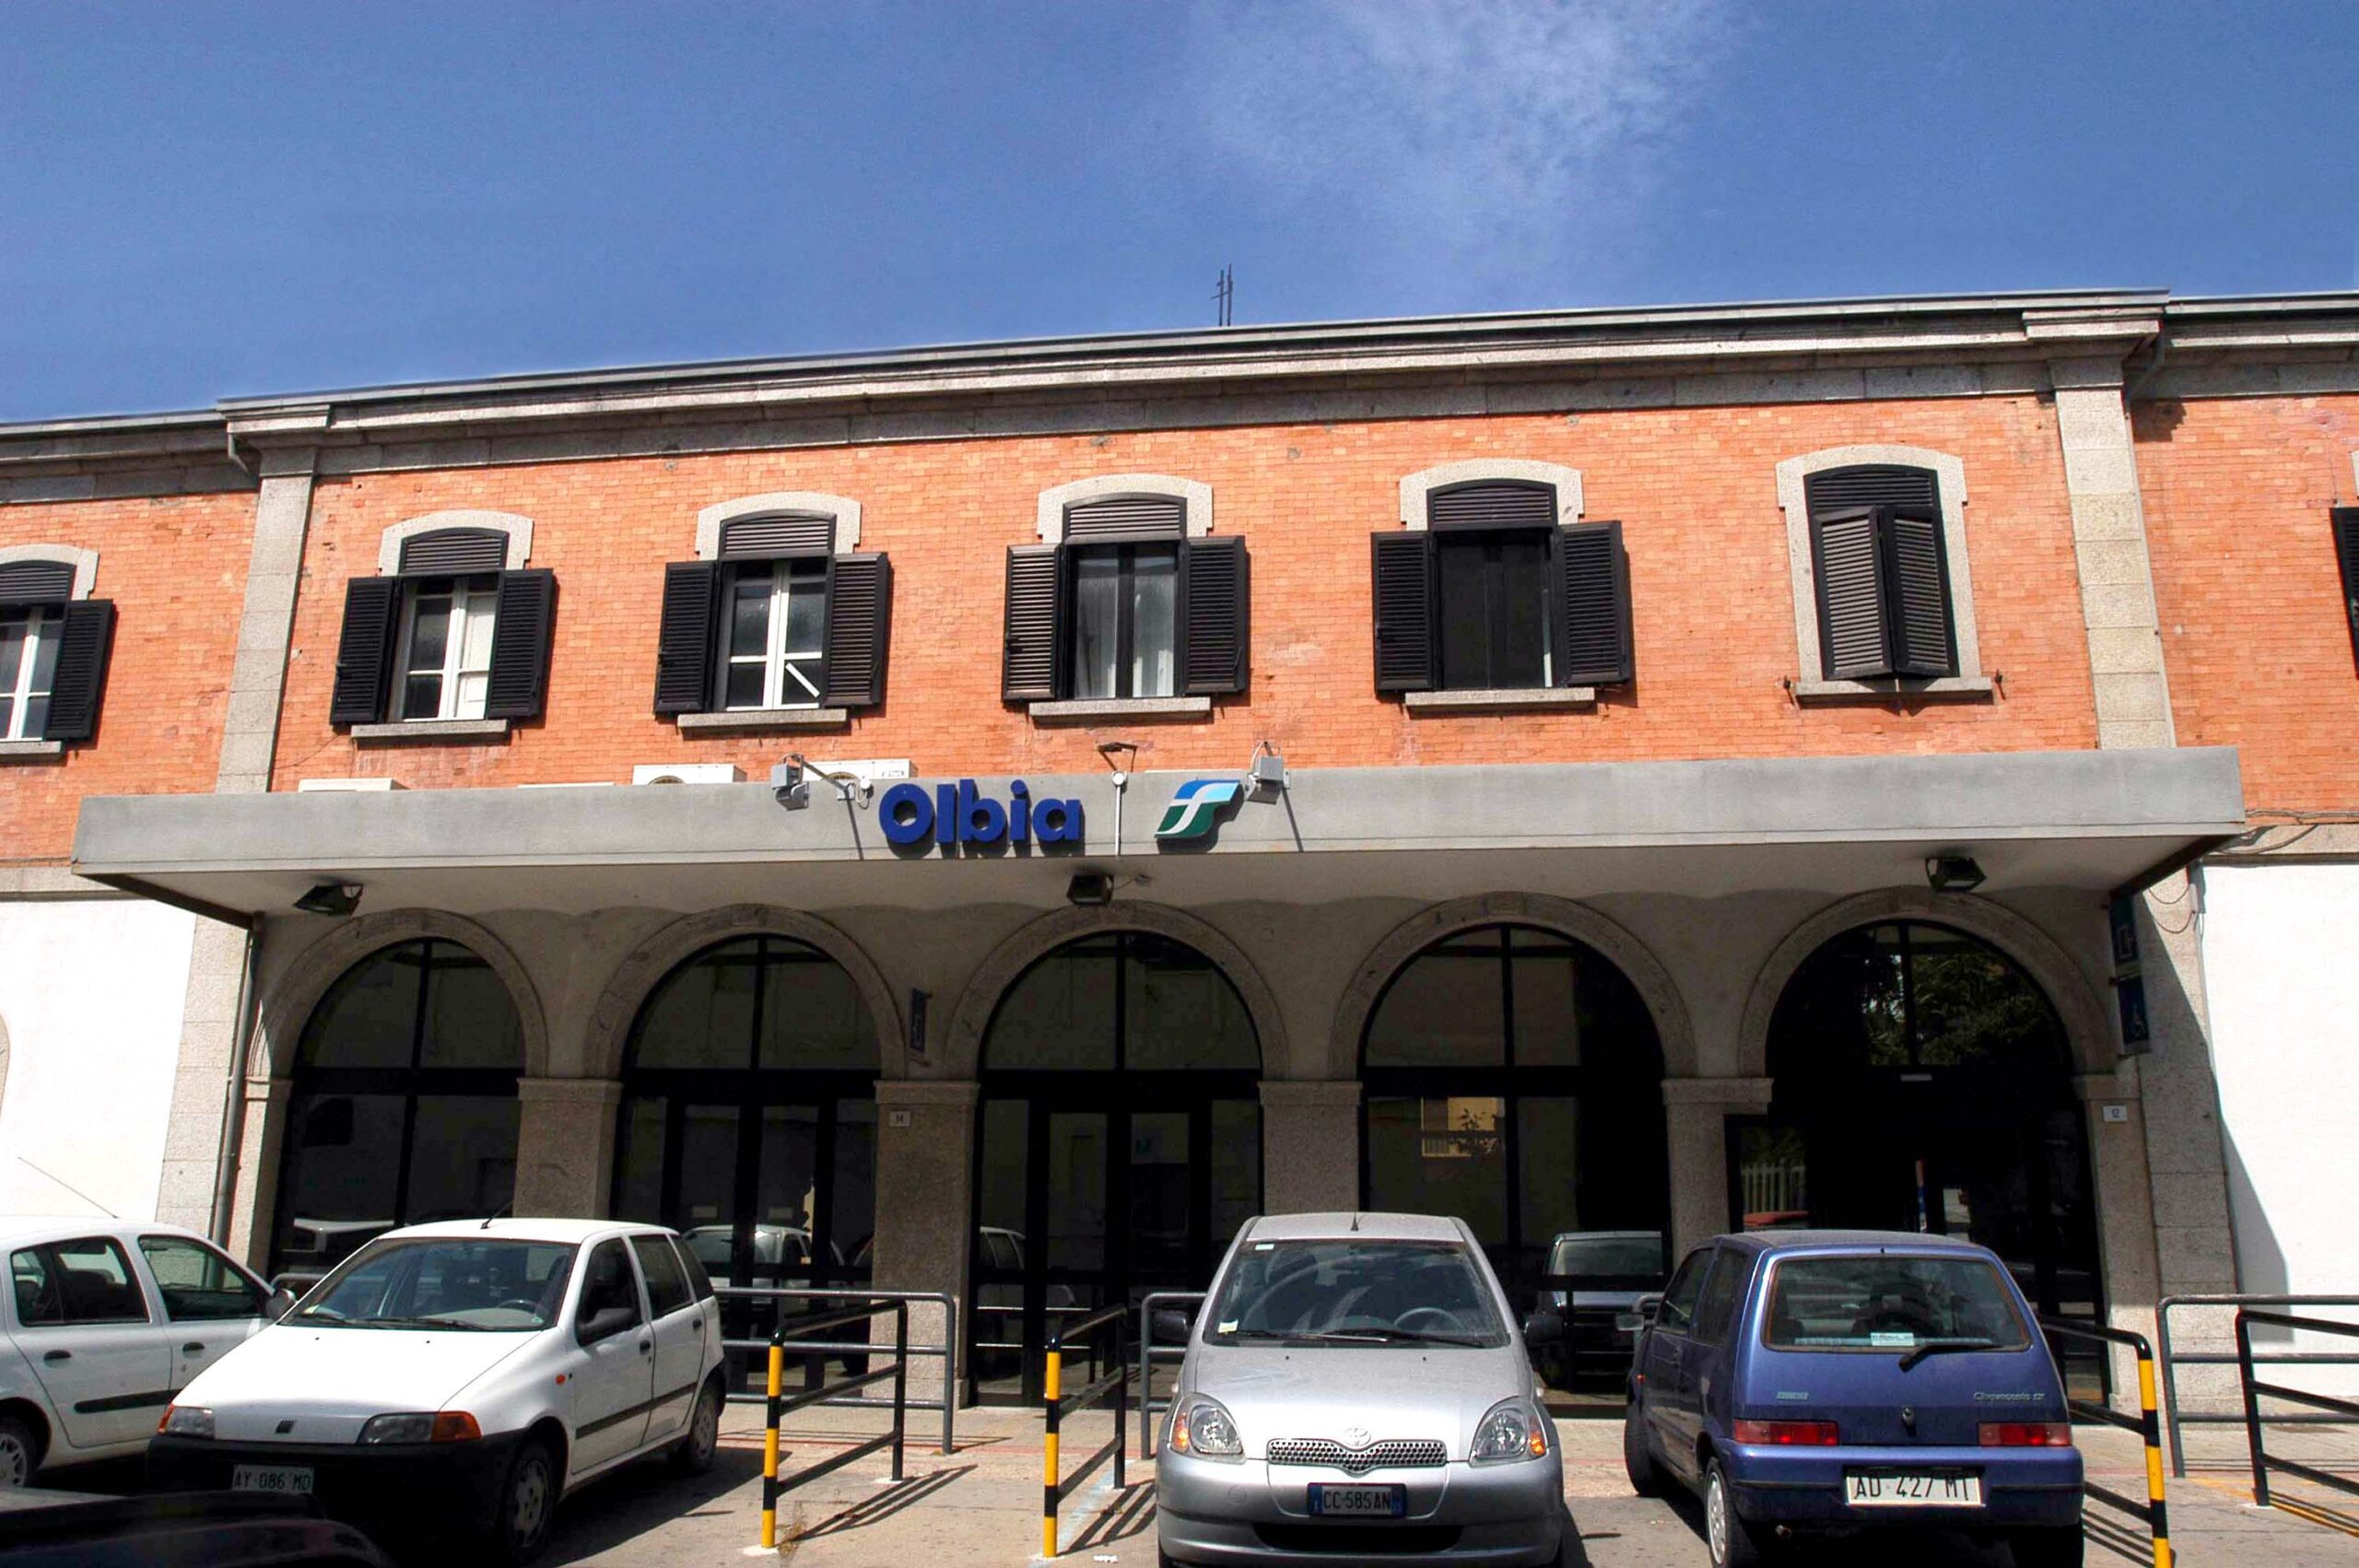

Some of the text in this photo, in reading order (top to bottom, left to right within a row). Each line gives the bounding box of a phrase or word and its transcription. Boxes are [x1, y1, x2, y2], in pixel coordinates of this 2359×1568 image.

[878, 778, 1080, 843] Olbia
[259, 1472, 286, 1489] 086
[1855, 1475, 1882, 1498] AD
[1895, 1475, 1933, 1498] 427
